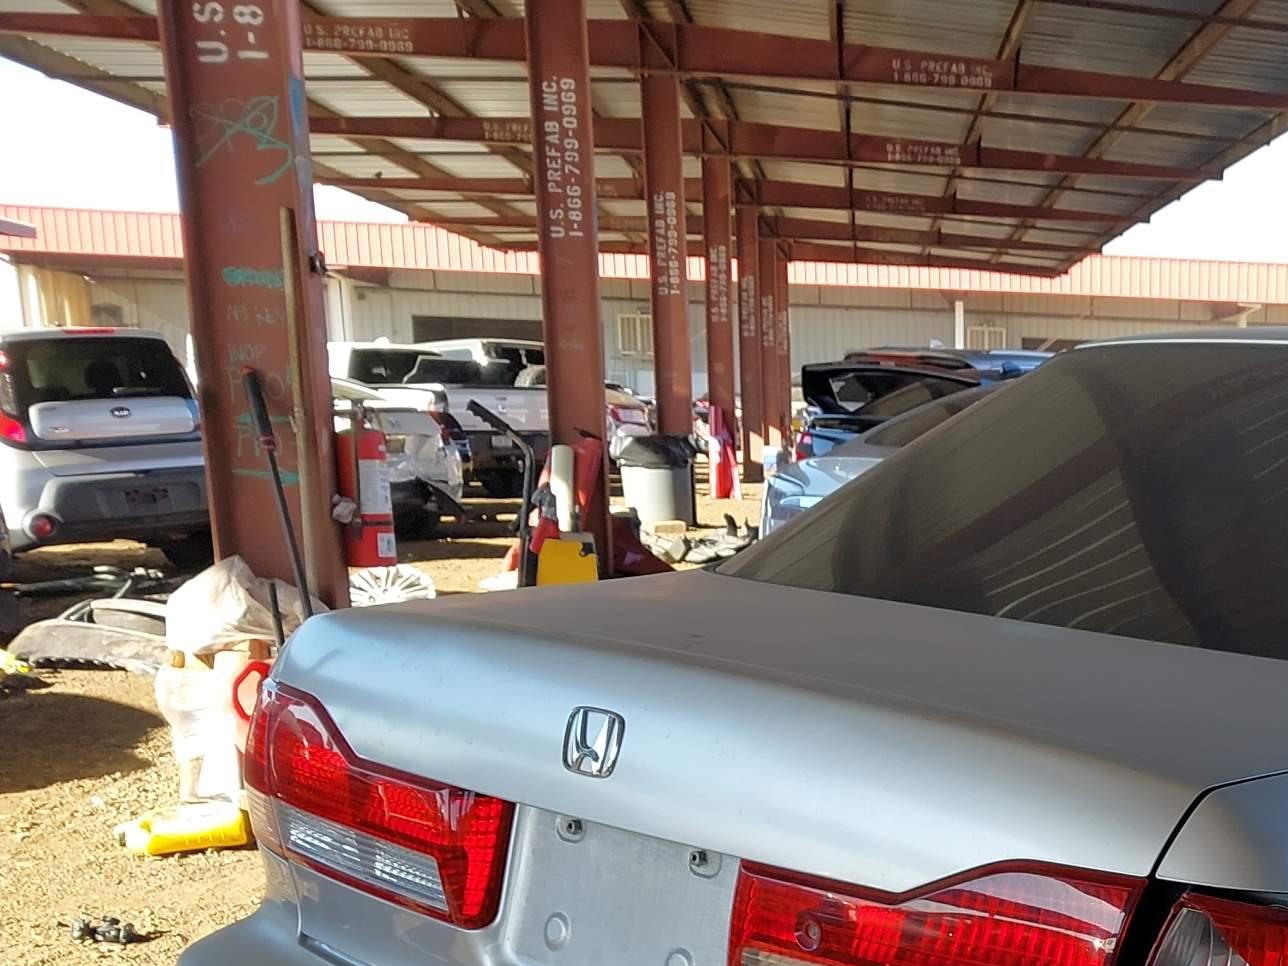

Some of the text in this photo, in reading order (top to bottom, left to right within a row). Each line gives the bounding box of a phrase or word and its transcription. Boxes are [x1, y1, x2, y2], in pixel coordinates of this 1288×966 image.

[541, 75, 567, 238] U.S. PREFAB INC.
[559, 77, 585, 238] 1-866-799-0969
